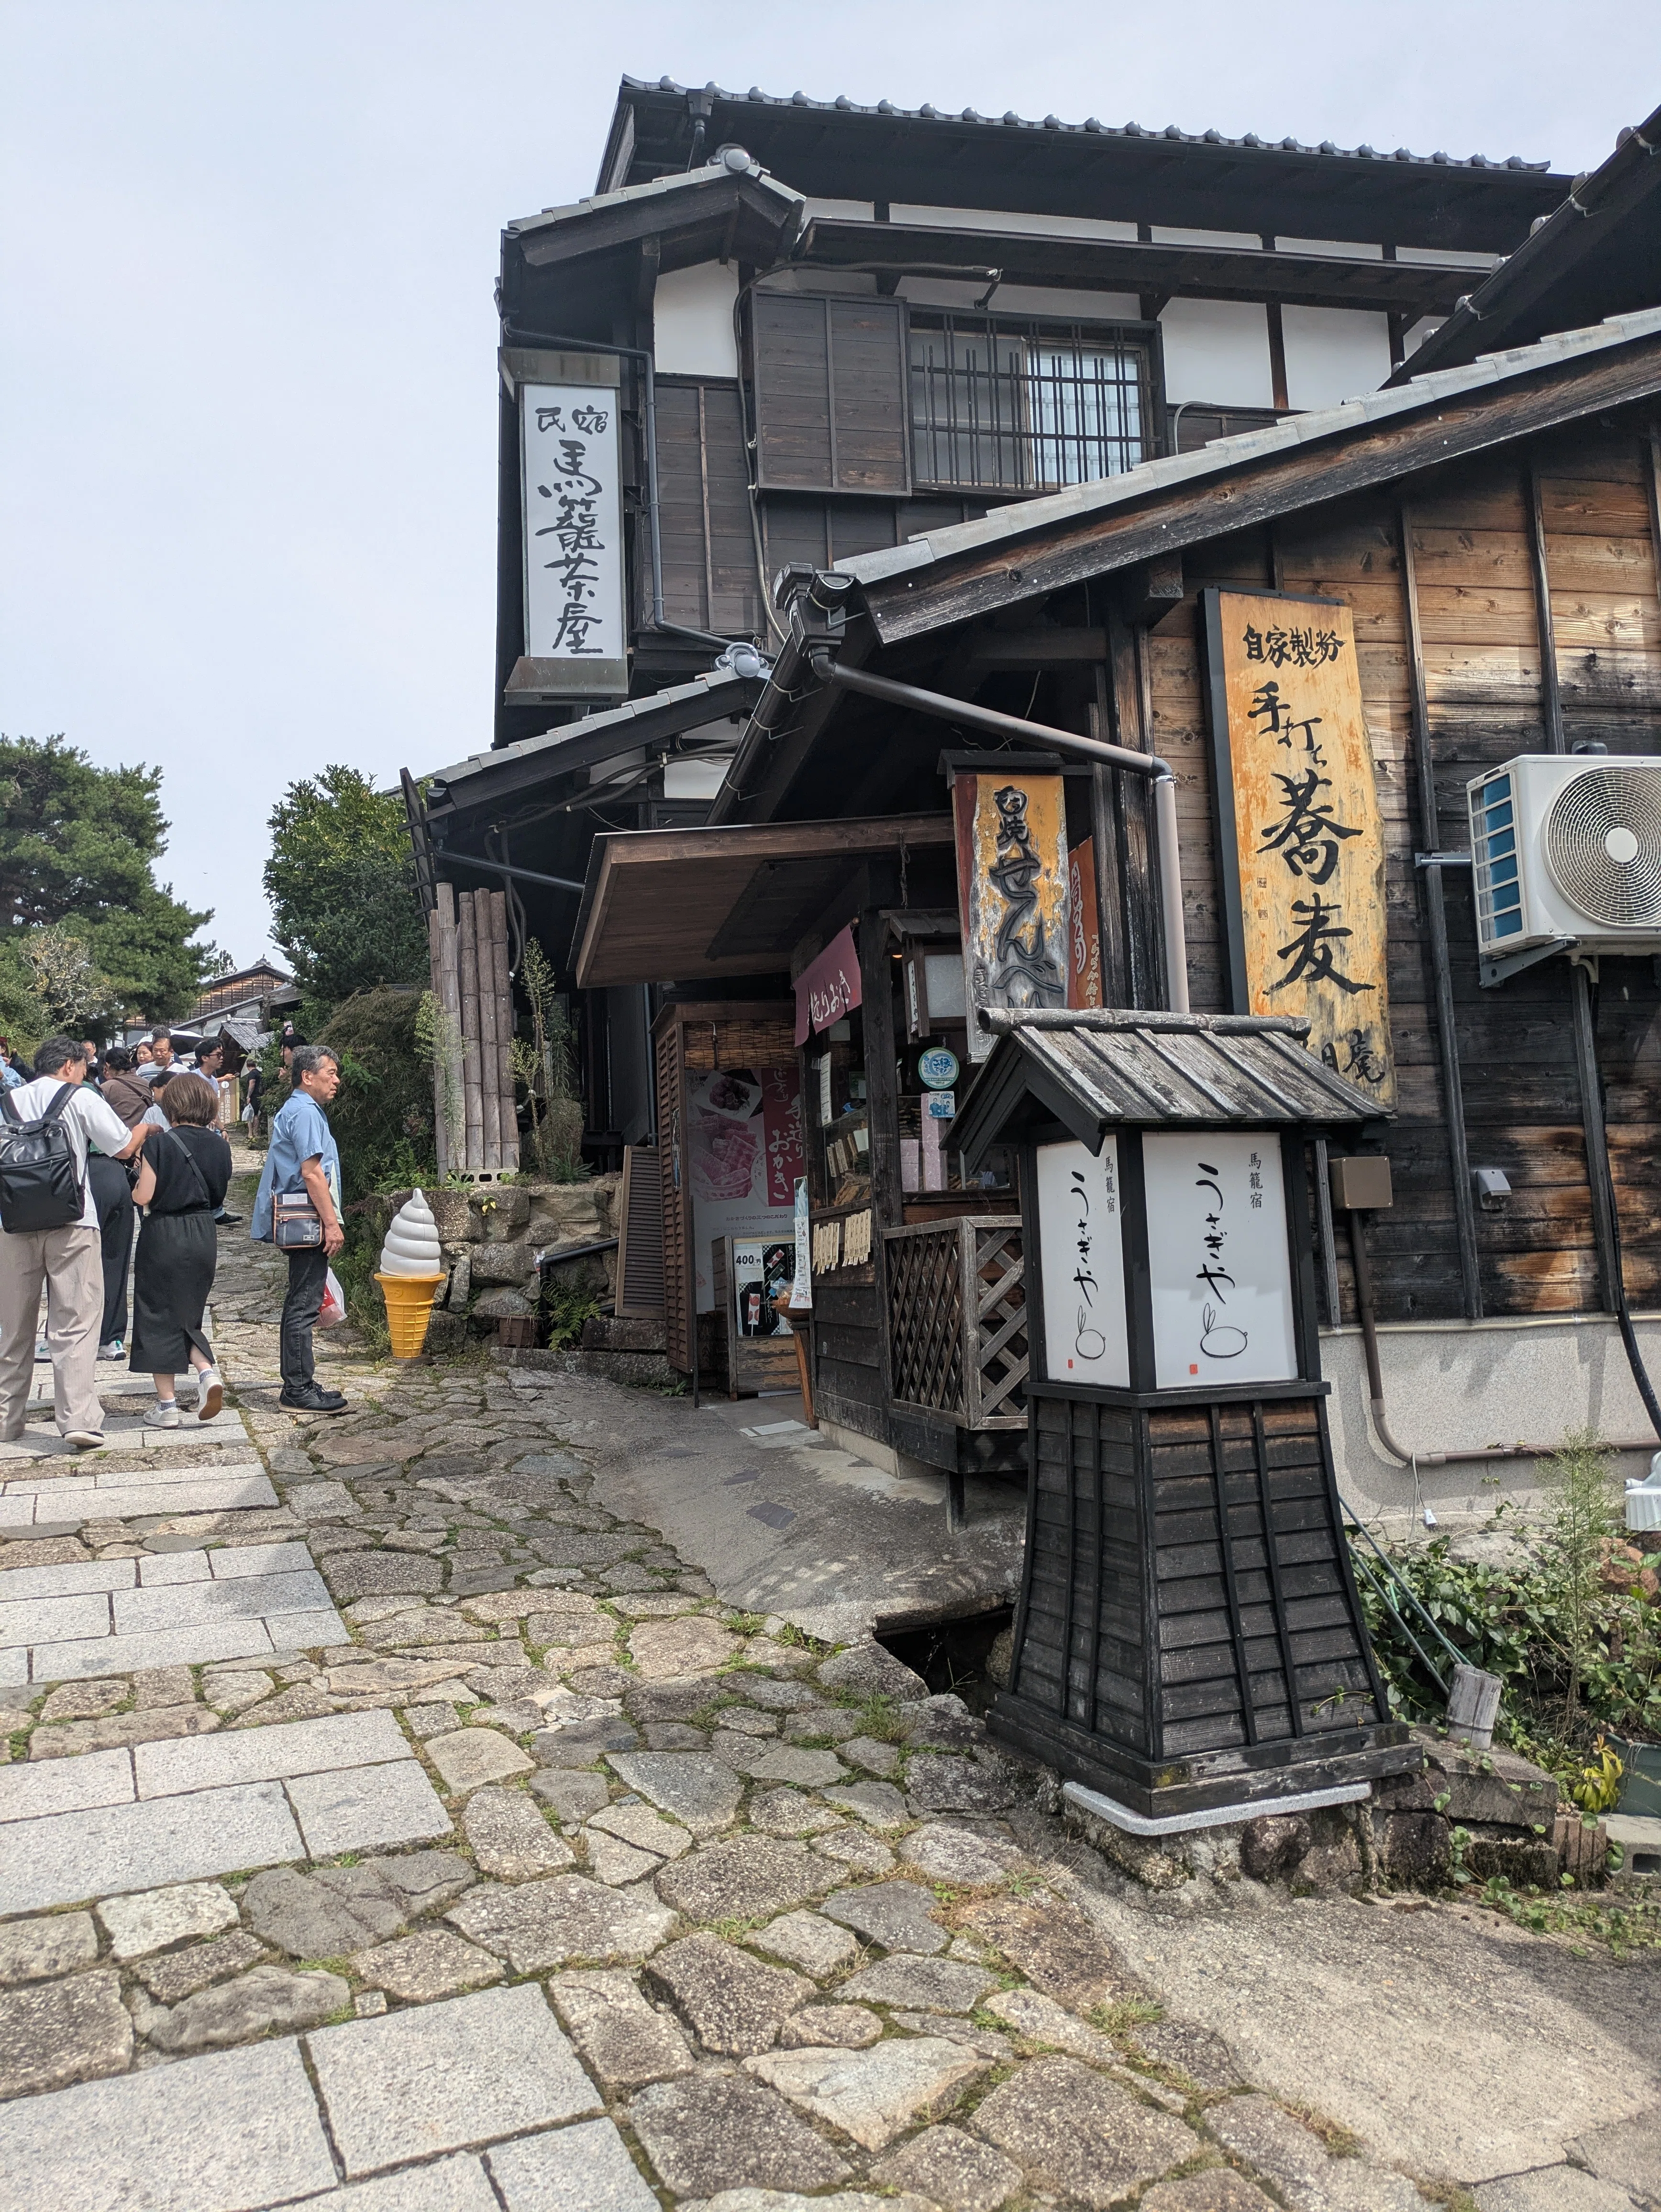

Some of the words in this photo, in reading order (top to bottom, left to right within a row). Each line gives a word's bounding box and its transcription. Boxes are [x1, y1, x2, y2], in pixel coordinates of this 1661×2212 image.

[535, 405, 608, 434] 民宿
[535, 439, 605, 653] 馬籠茶屋
[1243, 623, 1347, 669] 自家製粉
[1104, 1156, 1116, 1214] 馬籠宿
[1248, 1152, 1264, 1209] 馬籠宿
[1071, 1171, 1098, 1308] うさぎや
[1196, 1163, 1235, 1305] うさぎや
